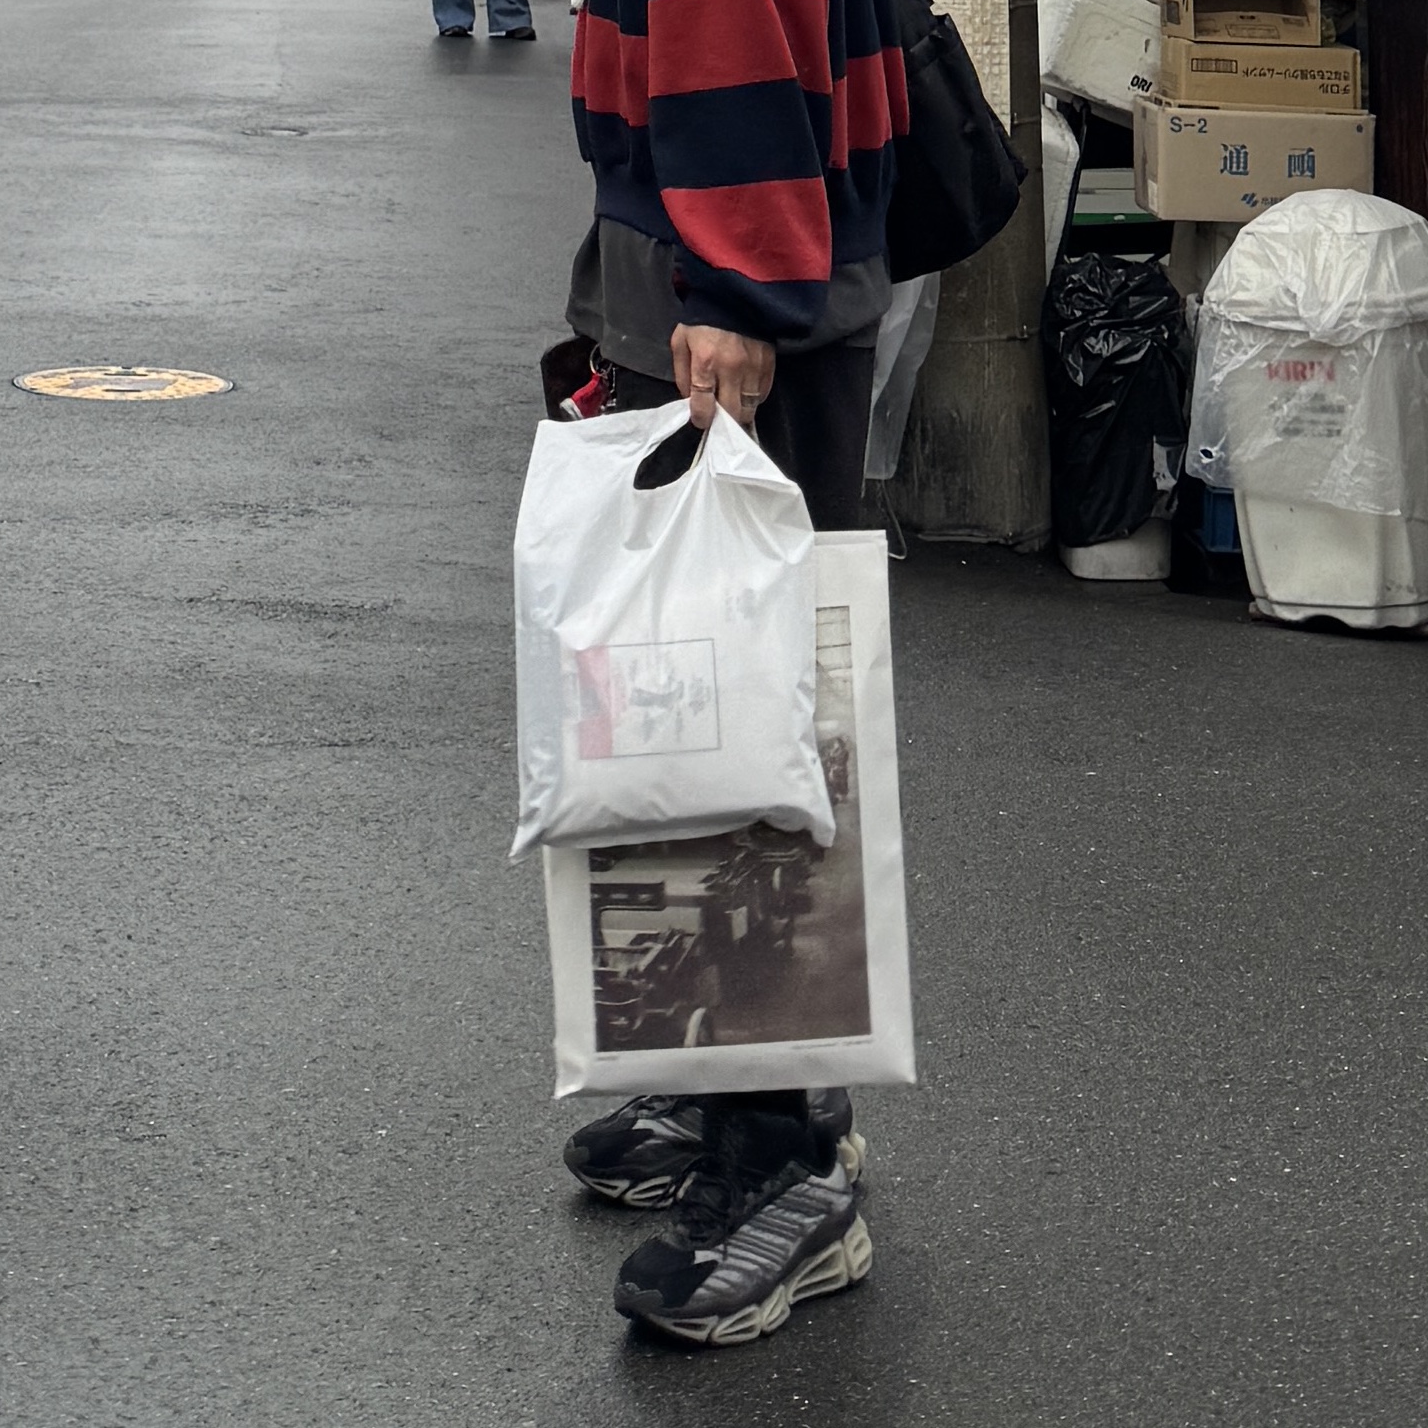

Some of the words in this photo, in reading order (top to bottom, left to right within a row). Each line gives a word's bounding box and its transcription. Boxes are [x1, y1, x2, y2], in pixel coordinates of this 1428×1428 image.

[1318, 84, 1351, 95] チロル
[1170, 116, 1208, 134] S-2
